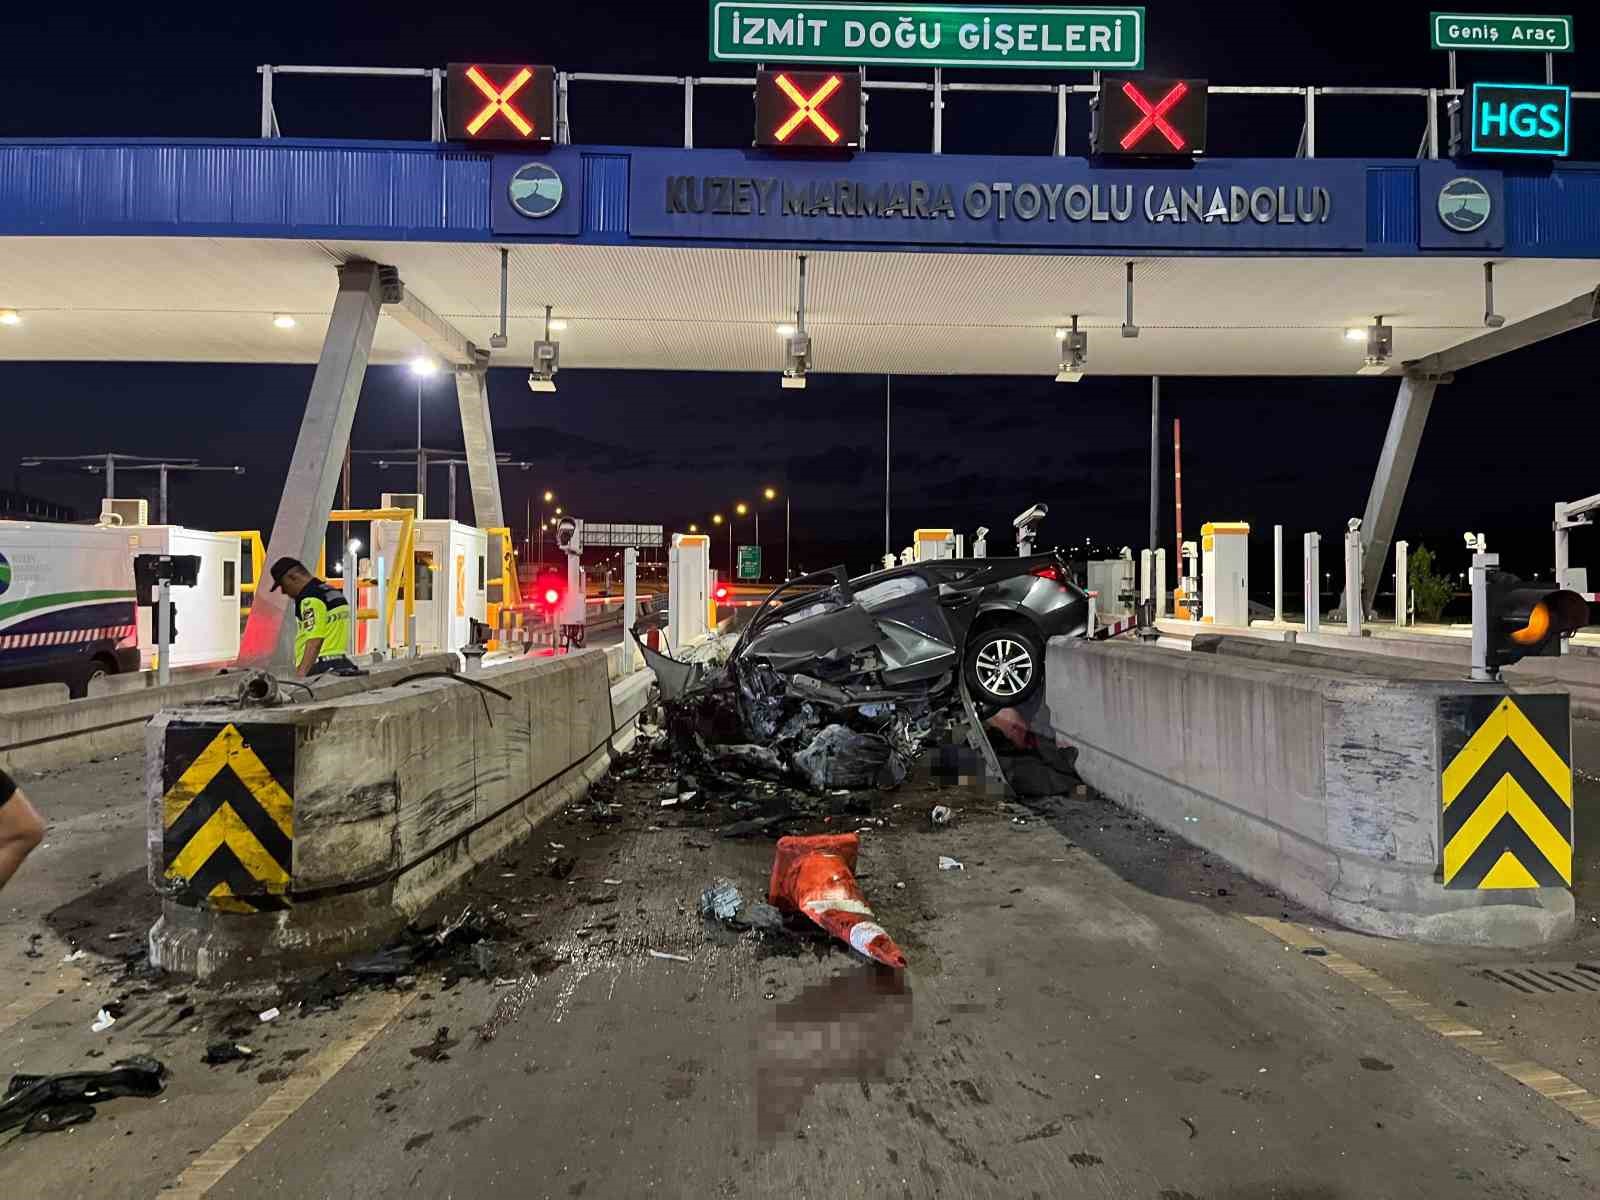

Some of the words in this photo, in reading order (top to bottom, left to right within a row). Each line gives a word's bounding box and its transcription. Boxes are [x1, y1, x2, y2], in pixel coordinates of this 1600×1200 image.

[732, 11, 828, 47] İZMİT
[844, 17, 941, 49] DOĞU
[958, 17, 1122, 55] GİŞELERİ
[1449, 25, 1499, 41] Geniş
[1512, 26, 1556, 42] Araç
[1481, 102, 1562, 138] HGS
[666, 176, 777, 215] KUZEY
[782, 181, 955, 219] MARMARA
[965, 182, 1133, 221] OTOYOLU
[1144, 185, 1331, 223] (ANADOLU)
